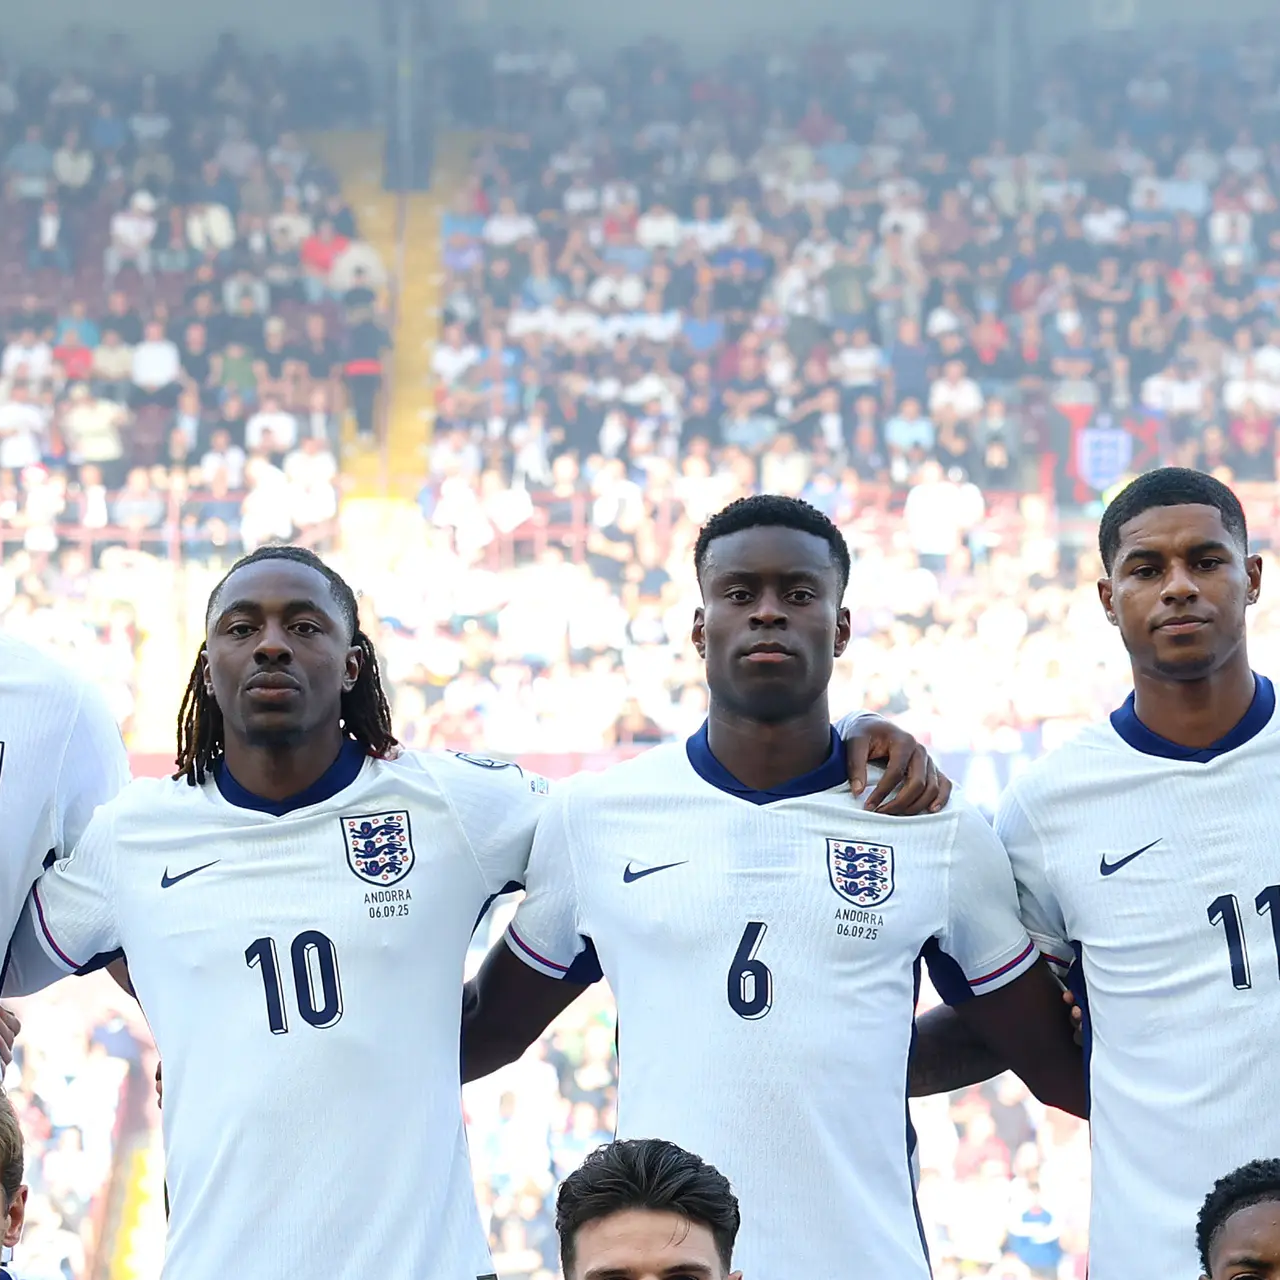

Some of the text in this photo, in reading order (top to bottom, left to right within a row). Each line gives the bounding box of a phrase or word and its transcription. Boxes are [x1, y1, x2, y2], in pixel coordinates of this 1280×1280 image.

[364, 888, 412, 904] ANDORRA
[369, 903, 409, 918] 06.09.25
[834, 908, 884, 926] ANDORRA
[836, 923, 878, 940] 06.09.25
[727, 922, 773, 1020] 6
[245, 930, 343, 1035] 10
